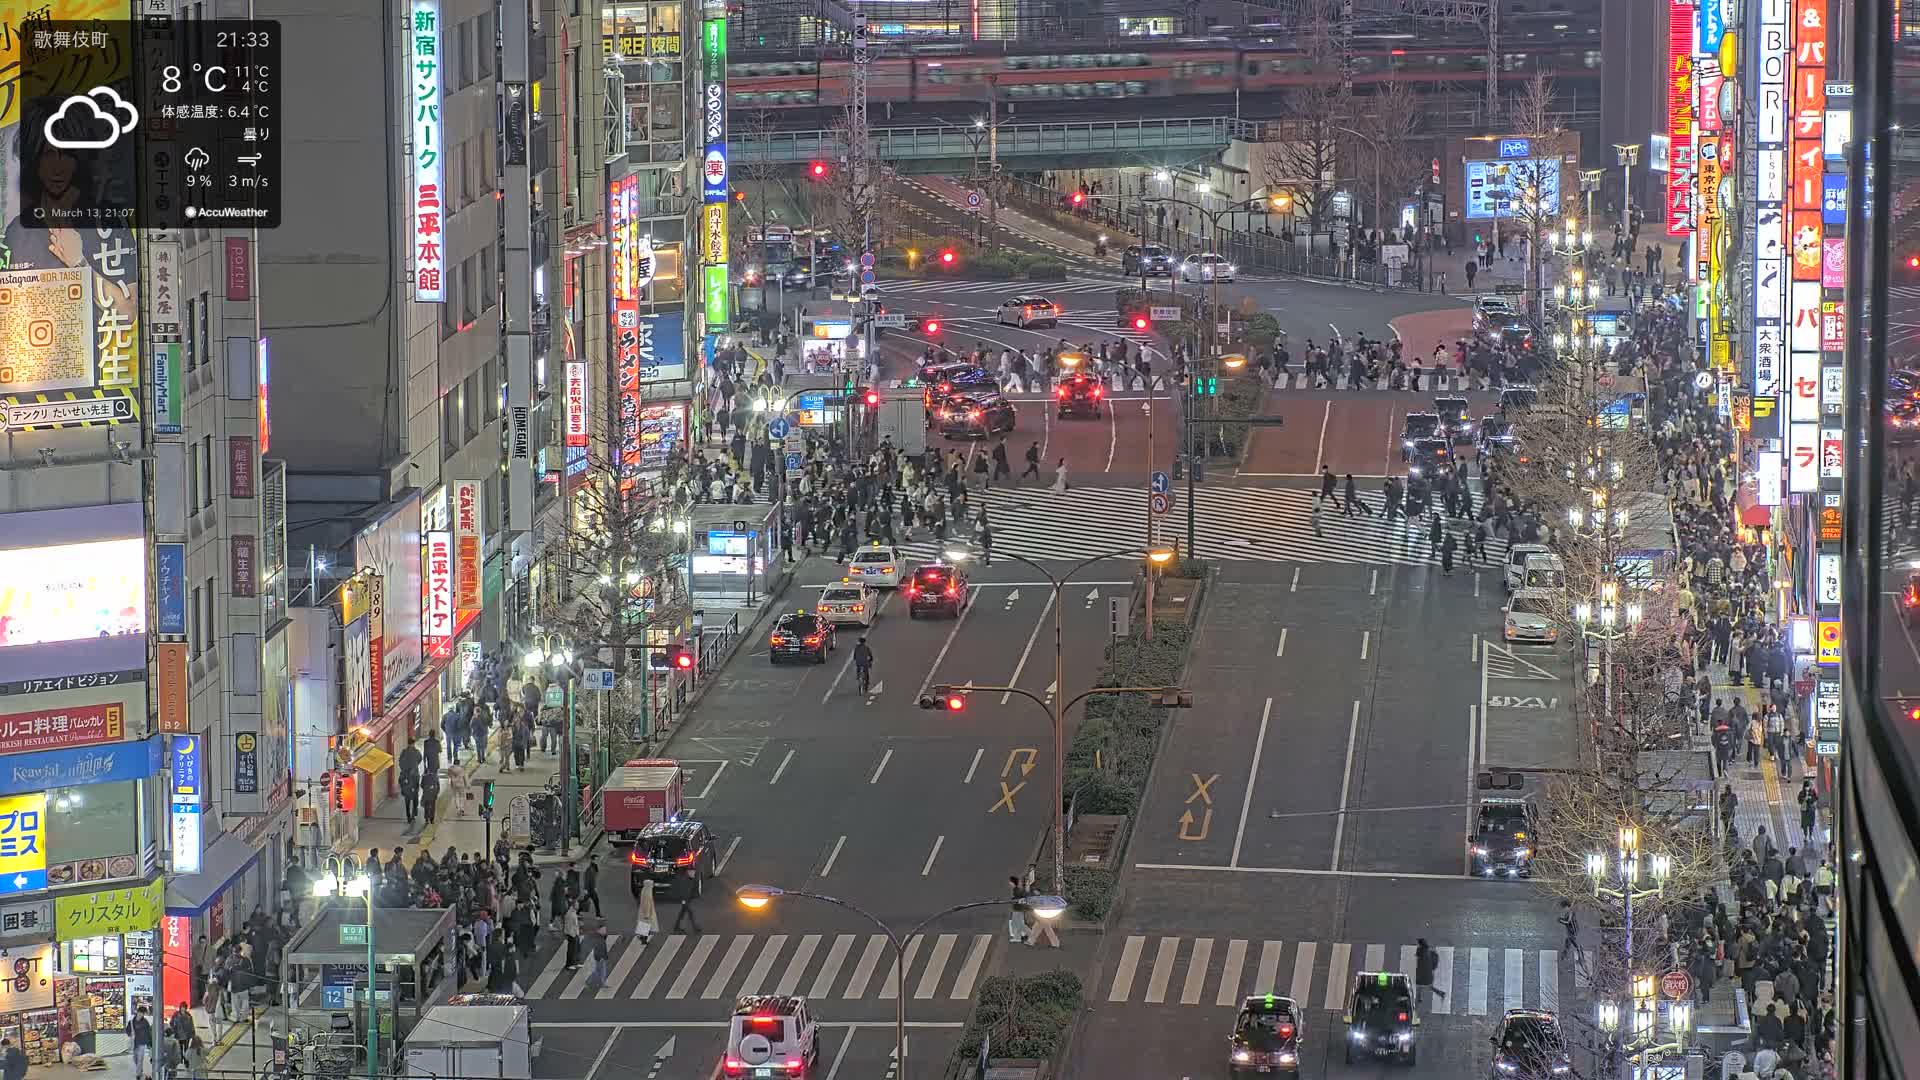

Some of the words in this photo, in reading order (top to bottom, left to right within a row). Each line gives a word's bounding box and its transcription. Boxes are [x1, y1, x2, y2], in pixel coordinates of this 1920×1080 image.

[414, 11, 438, 169] 新宿サンパーク
[1705, 87, 1716, 120] アコム
[707, 161, 723, 177] 薬
[417, 184, 441, 291] 三平本館
[710, 208, 722, 262] 肉汁水餃子
[157, 324, 175, 333] 3F
[1758, 330, 1772, 381] 大衆酒場
[156, 353, 168, 413] FamilyMart
[1794, 307, 1818, 467] パセラ
[13, 409, 48, 421] テンクリ
[53, 403, 111, 418] たいせい先生
[1828, 404, 1841, 413] 5F
[514, 407, 527, 459] HOMEGAME
[460, 487, 470, 530] GAME
[432, 542, 448, 627] 三平ストア
[373, 581, 381, 618] 389
[23, 679, 74, 693] リアエイド
[78, 674, 119, 687] ビジョン
[108, 711, 118, 735] 5F
[24, 735, 68, 746] RESTAURANT
[0, 811, 39, 831] プロ
[1, 835, 39, 857] ミス
[3, 911, 38, 931] 囲碁
[69, 902, 141, 927] クリスタル
[325, 990, 342, 1003] 12
